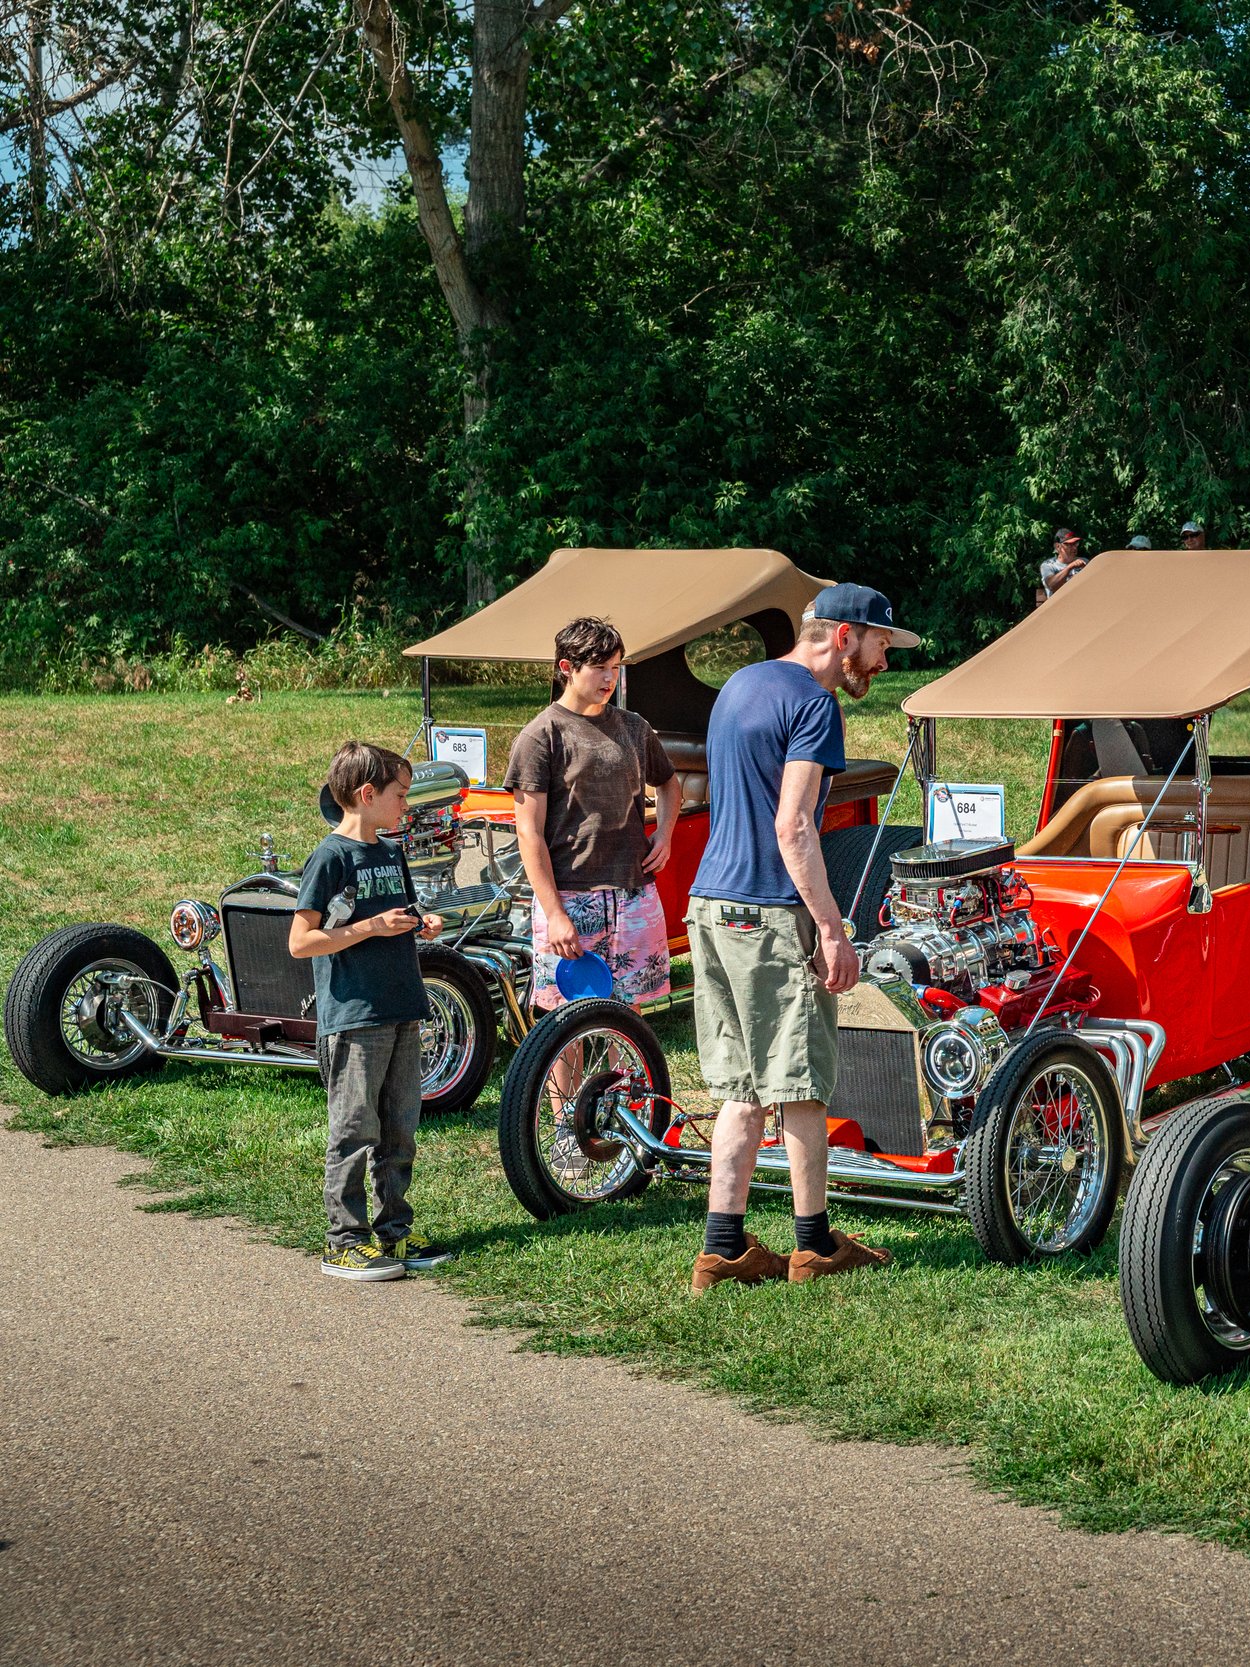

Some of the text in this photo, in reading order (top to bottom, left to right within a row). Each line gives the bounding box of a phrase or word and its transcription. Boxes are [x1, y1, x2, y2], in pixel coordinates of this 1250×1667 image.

[452, 743, 467, 752] 683
[411, 769, 435, 781] DS
[957, 802, 976, 814] 684
[356, 868, 372, 882] MY
[374, 866, 397, 878] GAME
